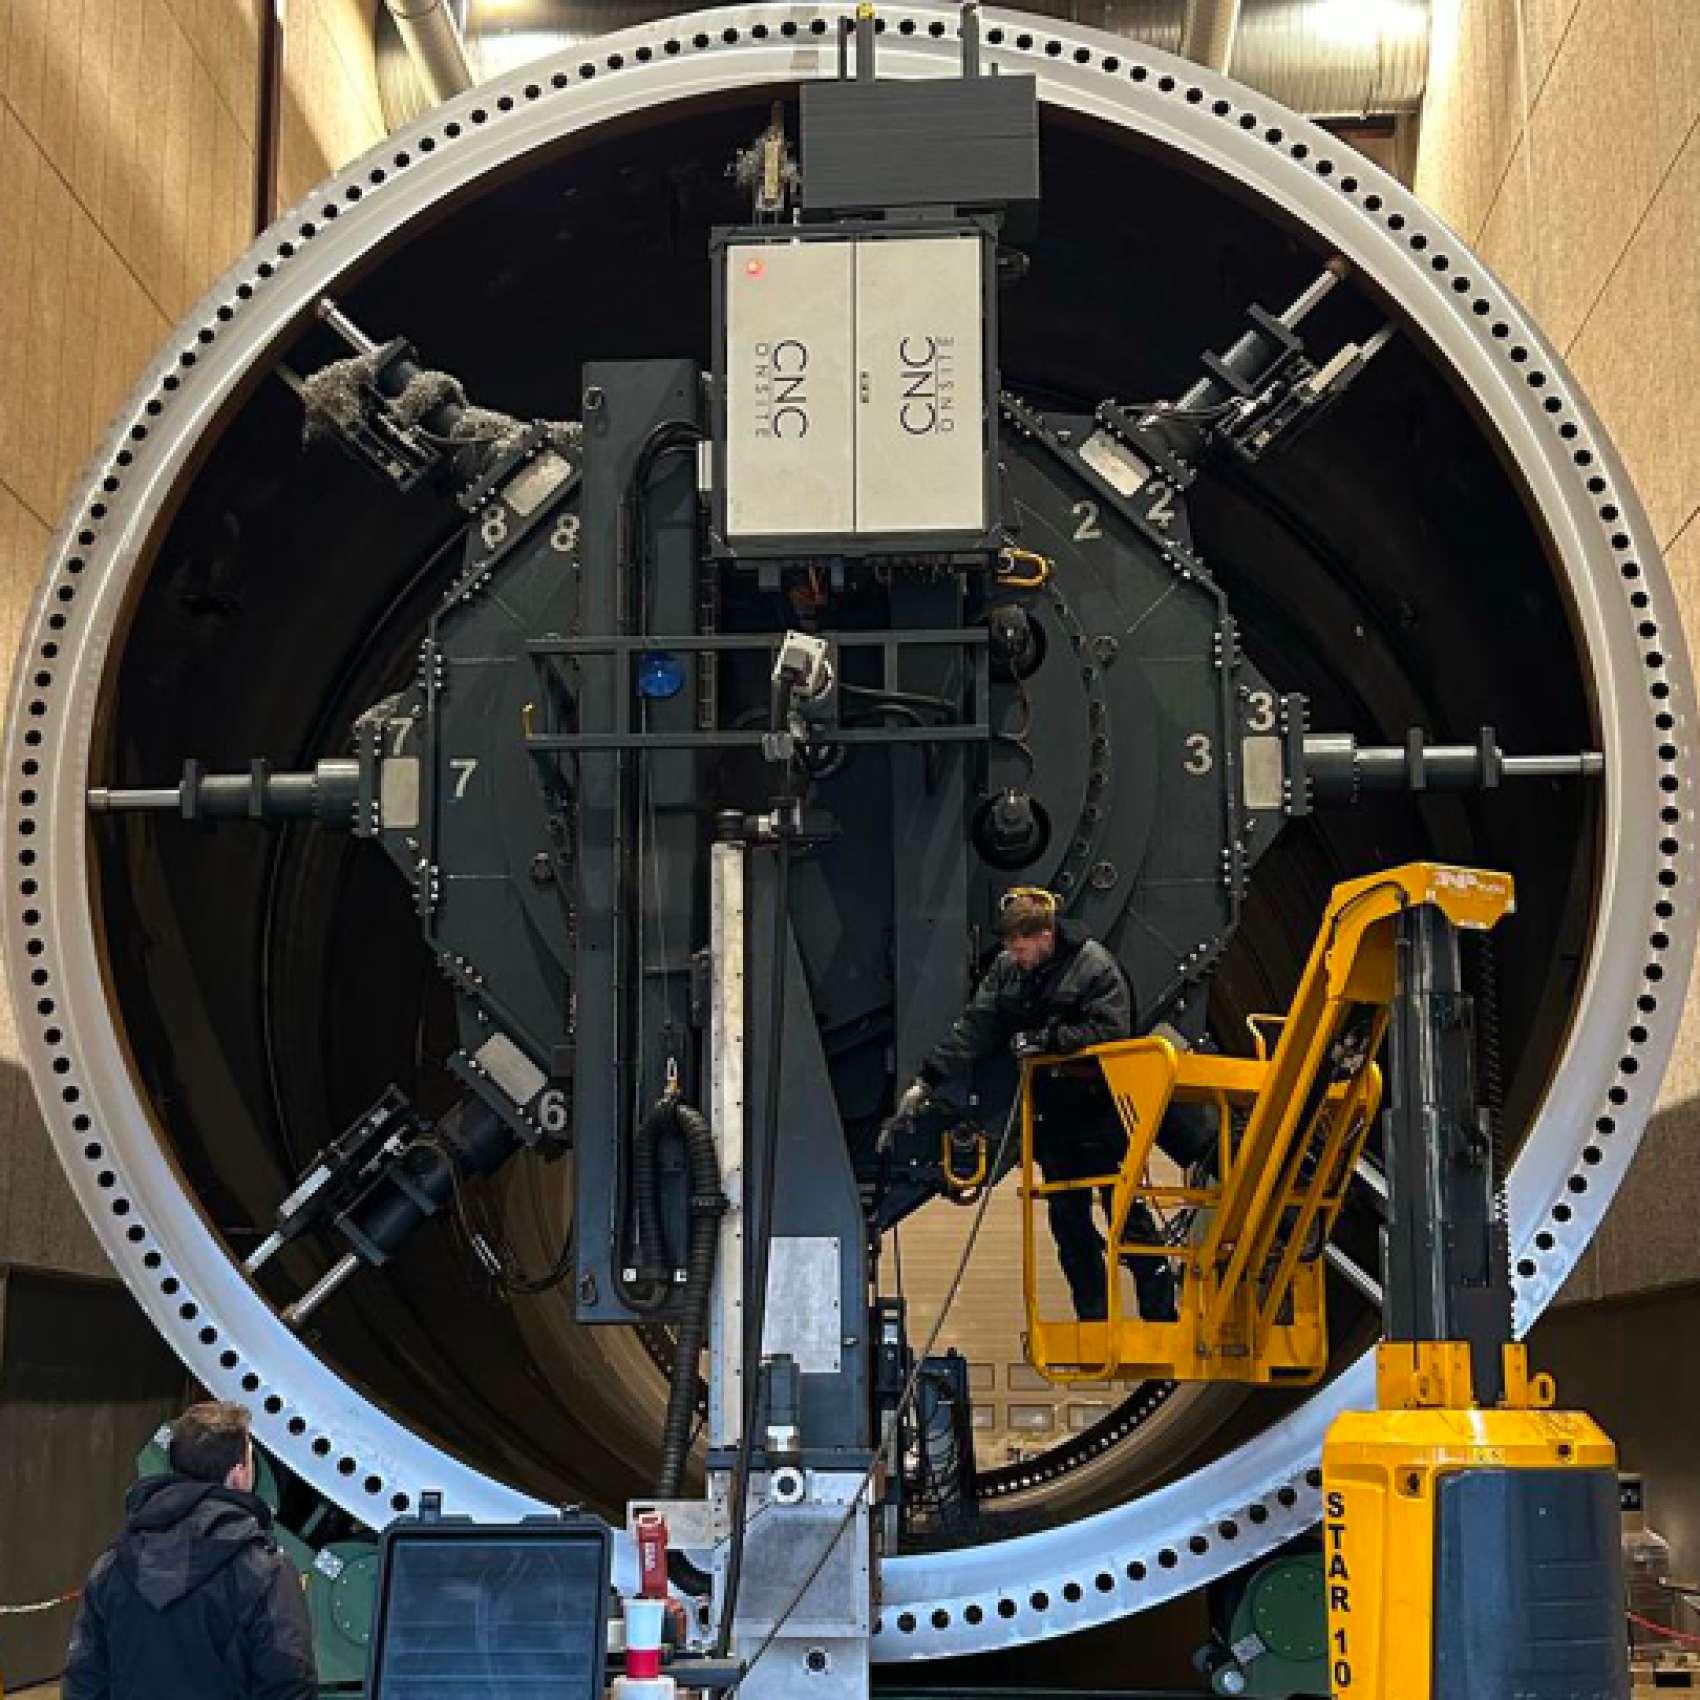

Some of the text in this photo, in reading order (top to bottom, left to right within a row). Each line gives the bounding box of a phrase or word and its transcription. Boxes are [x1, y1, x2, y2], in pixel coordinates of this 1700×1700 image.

[755, 343, 769, 438] ONSITE
[772, 340, 808, 438] CNC
[900, 337, 935, 435] CNC
[937, 337, 954, 432] ONSITE
[482, 506, 507, 547] 8
[551, 513, 580, 551] 8
[1073, 501, 1102, 541] 2
[1247, 691, 1275, 731] 3
[390, 718, 413, 756] 7
[1183, 733, 1213, 774] 3
[449, 758, 478, 797] 7
[540, 1089, 567, 1130] 6
[1327, 1491, 1351, 1688] STAR 10
